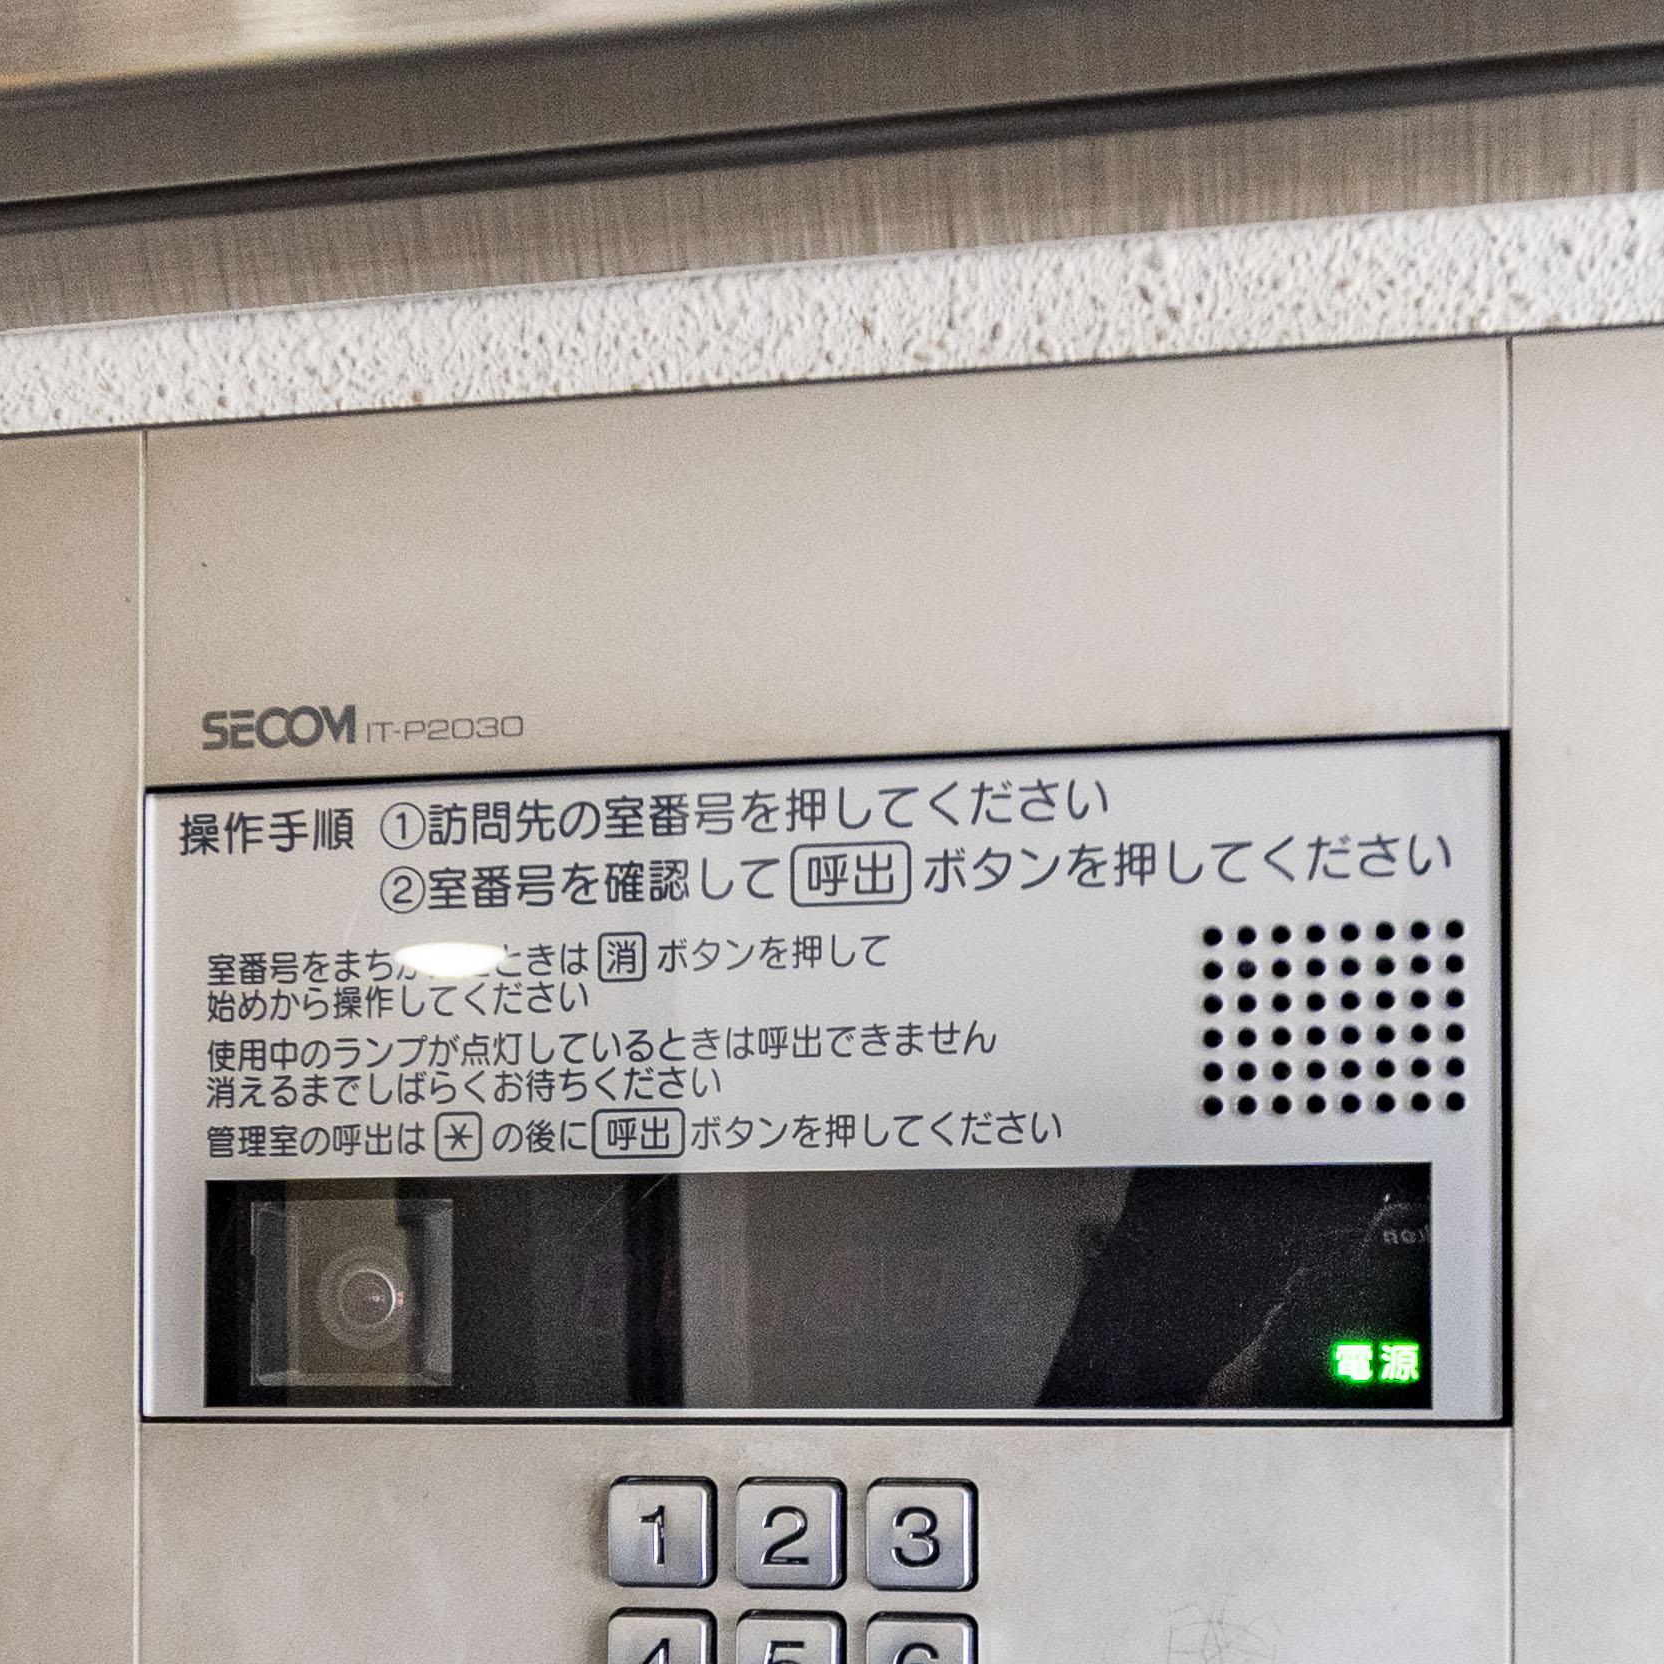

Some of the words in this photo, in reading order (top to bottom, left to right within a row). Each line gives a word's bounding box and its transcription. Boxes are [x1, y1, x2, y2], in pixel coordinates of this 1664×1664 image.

[203, 705, 356, 750] SECOM
[365, 715, 525, 744] IT-P2030
[180, 808, 353, 856] 操作手順
[208, 943, 588, 986] 室番号をまちときは
[658, 935, 890, 973] ボタンを押して
[208, 982, 588, 1022] 始めから操作してください
[208, 1021, 996, 1072] 使用中のランプが点灯しているときは呼出できません
[207, 1066, 720, 1109] 消えるまでしばらくお待ちください
[1334, 1342, 1421, 1382] 電源
[638, 1504, 666, 1565] 1
[759, 1505, 810, 1566] 2
[890, 1506, 941, 1568] 3
